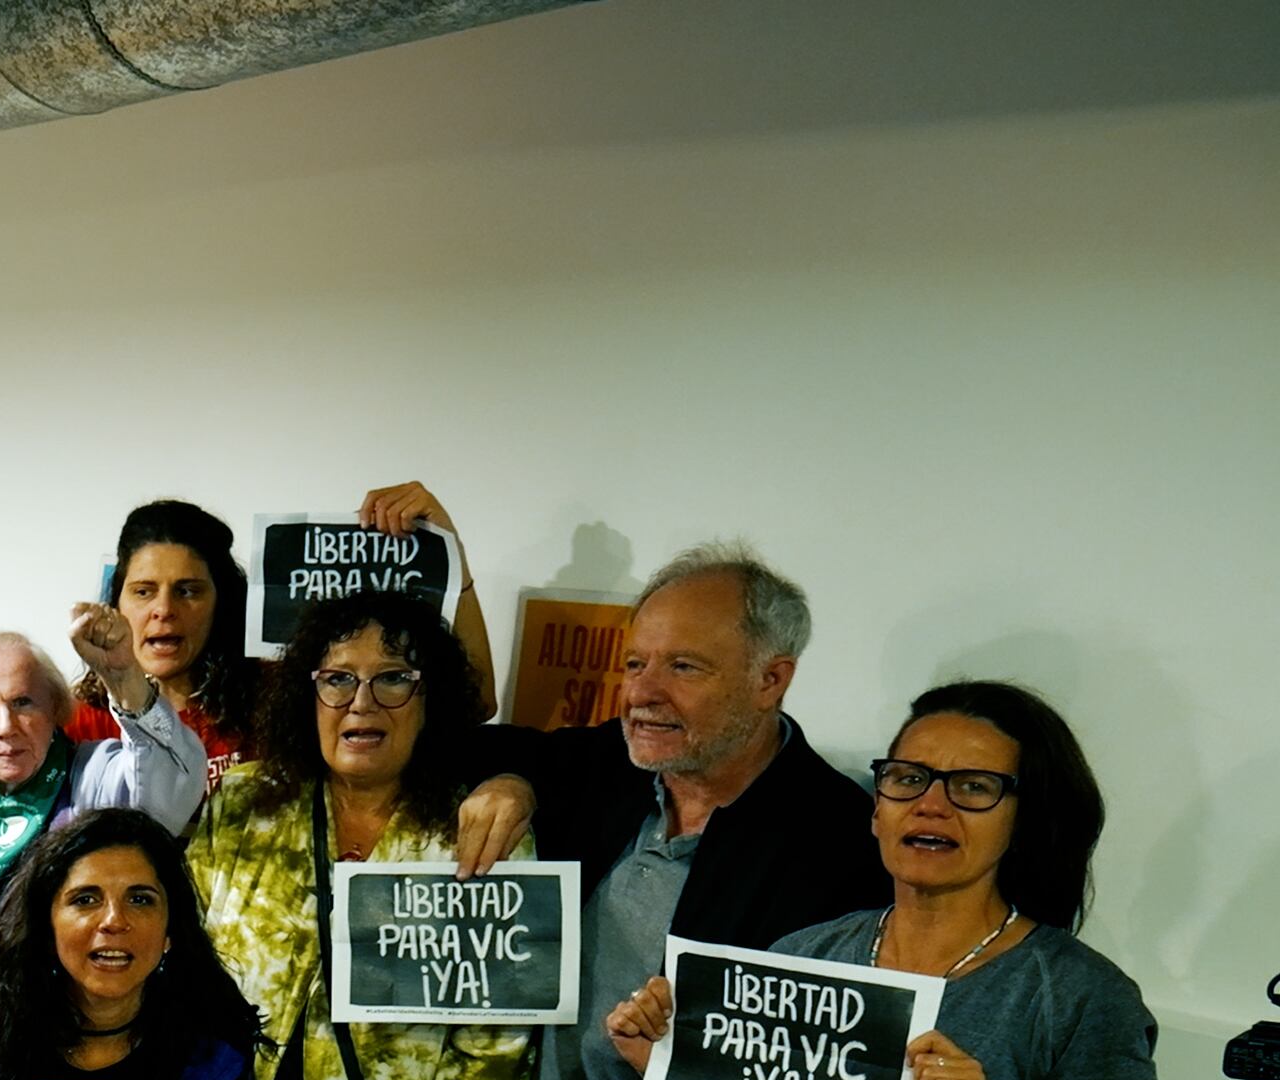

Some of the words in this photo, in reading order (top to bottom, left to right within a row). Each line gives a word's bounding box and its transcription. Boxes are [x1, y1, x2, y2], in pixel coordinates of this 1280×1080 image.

[289, 569, 362, 600] PARA
[377, 923, 462, 964] PARA
[468, 922, 532, 962] VIC
[420, 959, 491, 1008] ¡YA!
[703, 1013, 790, 1073] PARA
